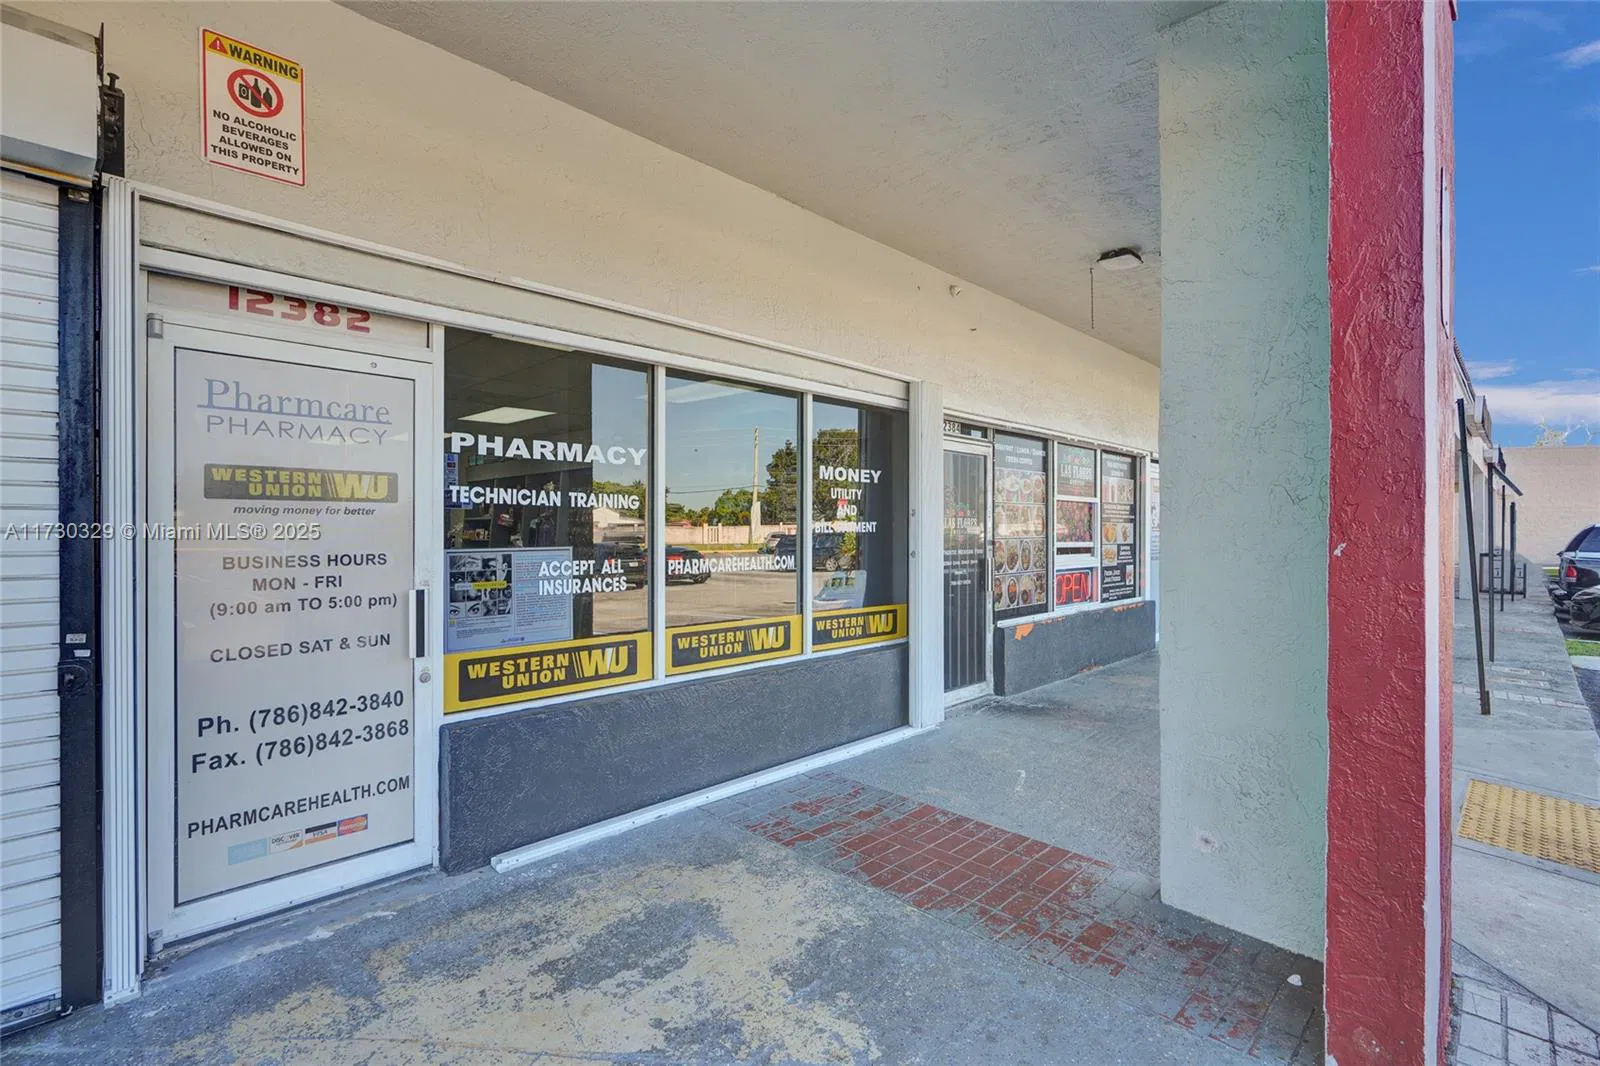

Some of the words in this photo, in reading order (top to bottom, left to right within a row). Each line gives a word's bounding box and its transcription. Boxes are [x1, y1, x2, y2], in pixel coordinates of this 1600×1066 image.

[229, 43, 299, 79] WARNING
[213, 110, 230, 121] NO
[233, 116, 297, 141] ALCOHOLIC
[222, 124, 289, 150] BEVERAGES
[211, 144, 238, 159] THIS
[242, 153, 299, 176] PROPERTY
[219, 135, 273, 157] ALLOWED
[276, 151, 292, 162] ON
[229, 286, 372, 334] 12382
[204, 378, 391, 424] Pharmcare
[206, 415, 388, 445] PHARMACY
[450, 431, 648, 466] PHARMACY
[211, 467, 321, 484] WESTERN
[331, 473, 389, 500] WU
[819, 465, 882, 484] MONEY
[248, 482, 321, 497] UNION
[449, 485, 561, 507] TECHNICIAN
[568, 491, 640, 511] TRAINING
[831, 487, 862, 500] UTILITY
[233, 504, 279, 517] moving
[282, 505, 322, 518] money
[324, 506, 340, 516] for
[343, 506, 376, 516] better
[837, 504, 858, 518] AND
[222, 554, 321, 571] BUSINESS
[327, 552, 388, 568] HOURS
[539, 559, 595, 577] ACCEPT
[601, 558, 624, 575] ALL
[667, 555, 796, 575] PHARMCAREHEALTH.COM
[252, 577, 296, 592] MON
[314, 574, 343, 589] FRI
[539, 576, 628, 596] INSURANCES
[1056, 573, 1089, 603] OPEN
[209, 601, 257, 620] (9:00
[264, 601, 292, 614] am
[298, 597, 322, 611] TO
[328, 595, 362, 609] 5:00
[368, 593, 398, 610] pm)
[815, 617, 864, 631] WESTERN
[831, 626, 863, 639] UNION
[210, 642, 292, 663] CLOSED
[299, 639, 333, 655] SAT
[339, 636, 351, 650] &
[356, 633, 391, 649] SUN
[677, 630, 745, 649] WESTERN
[699, 643, 742, 658] UNION
[751, 625, 785, 650] WU
[467, 652, 570, 680] WESTERN
[579, 645, 629, 678] WU
[501, 668, 566, 689] UNION
[197, 715, 240, 738] Ph.
[248, 690, 405, 734] (786)842-3840
[191, 749, 246, 774] Fax.
[255, 719, 410, 766] (786)842-3868
[187, 775, 410, 839] PHARMCAREHEALTH.COM
[271, 832, 300, 844] DISCVER
